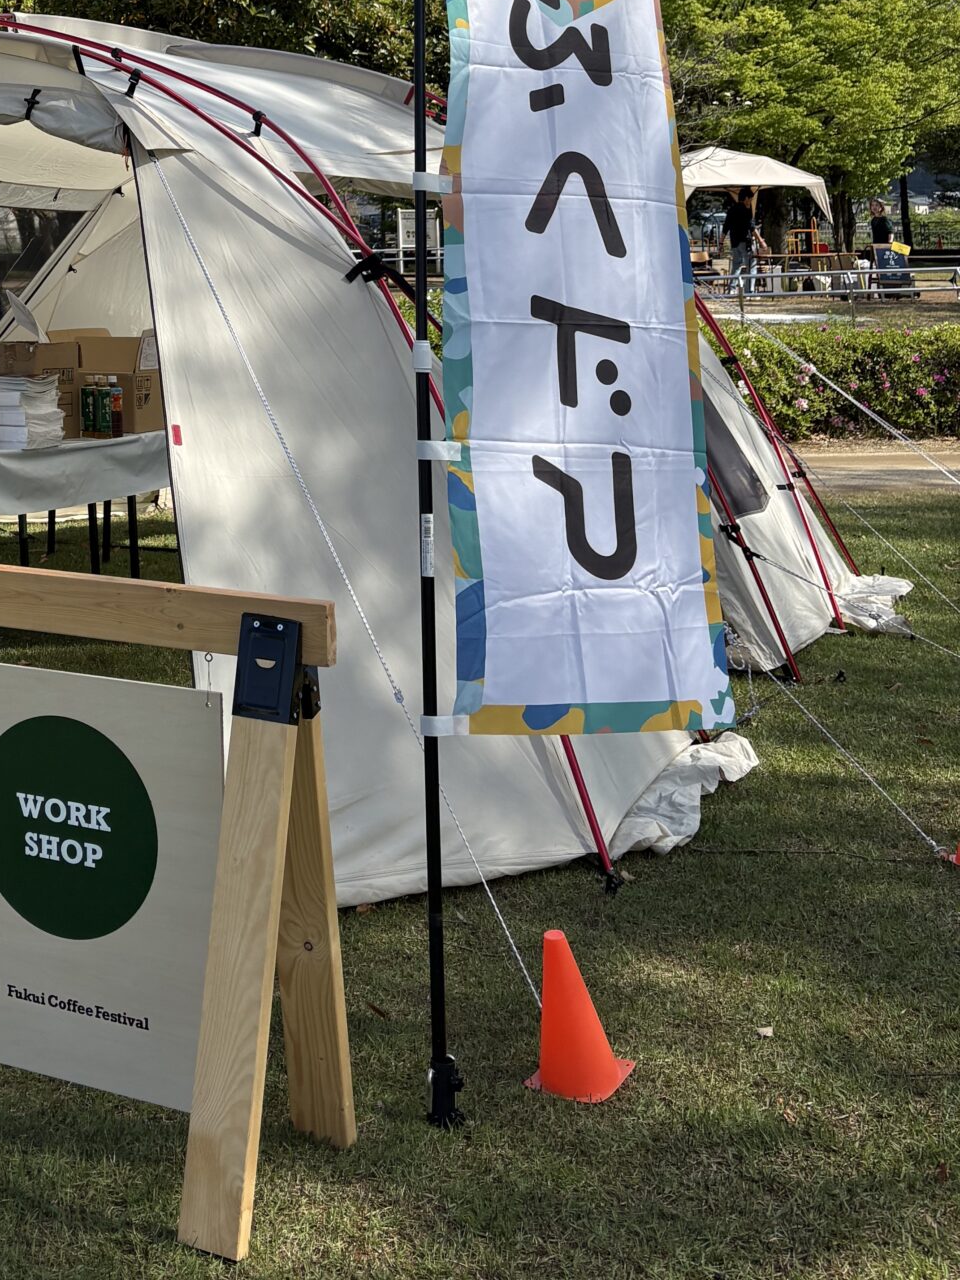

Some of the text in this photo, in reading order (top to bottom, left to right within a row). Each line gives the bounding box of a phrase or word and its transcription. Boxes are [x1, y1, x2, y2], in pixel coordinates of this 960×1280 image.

[16, 792, 112, 832] WORK
[24, 832, 103, 868] SHOP
[7, 984, 150, 1031] Fukui Coffee Festival
